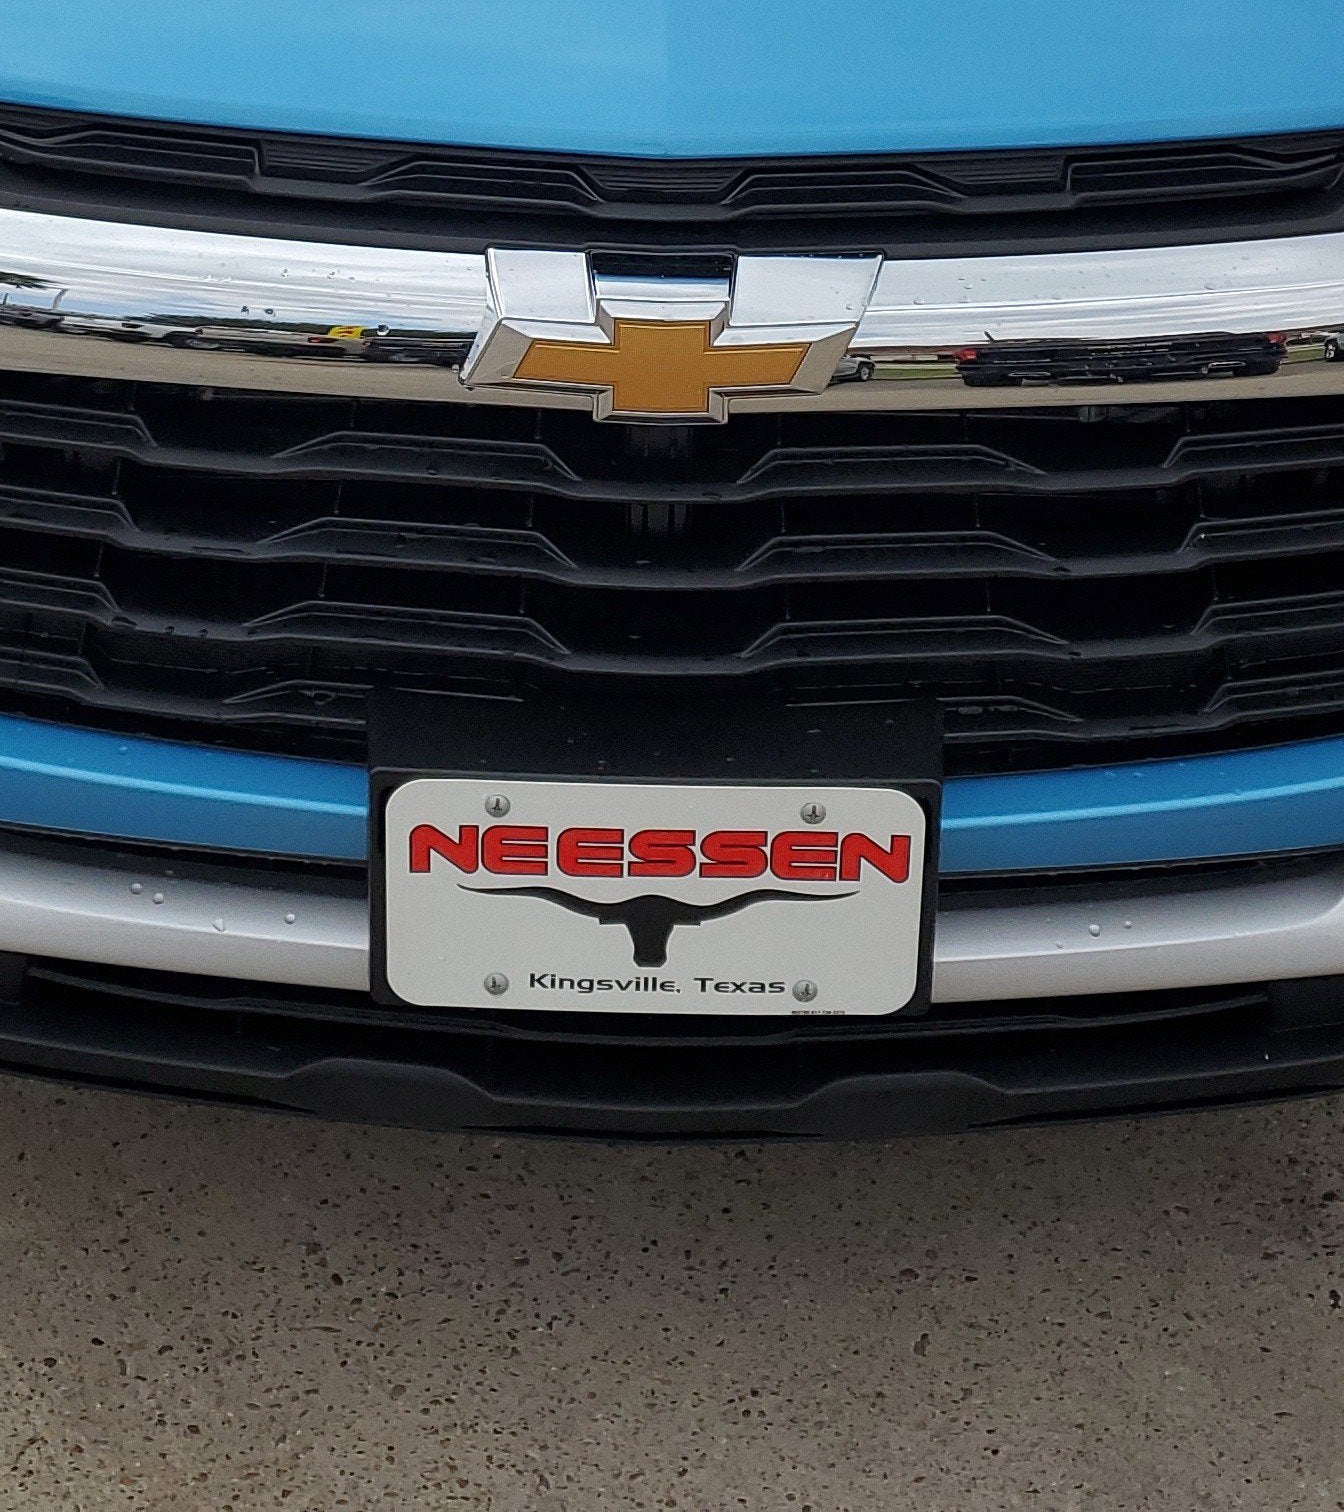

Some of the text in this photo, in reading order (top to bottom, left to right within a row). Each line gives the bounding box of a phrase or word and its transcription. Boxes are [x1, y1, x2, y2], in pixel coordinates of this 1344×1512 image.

[408, 823, 912, 884] NEESSEN
[529, 973, 786, 994] Kingsville, Texas
